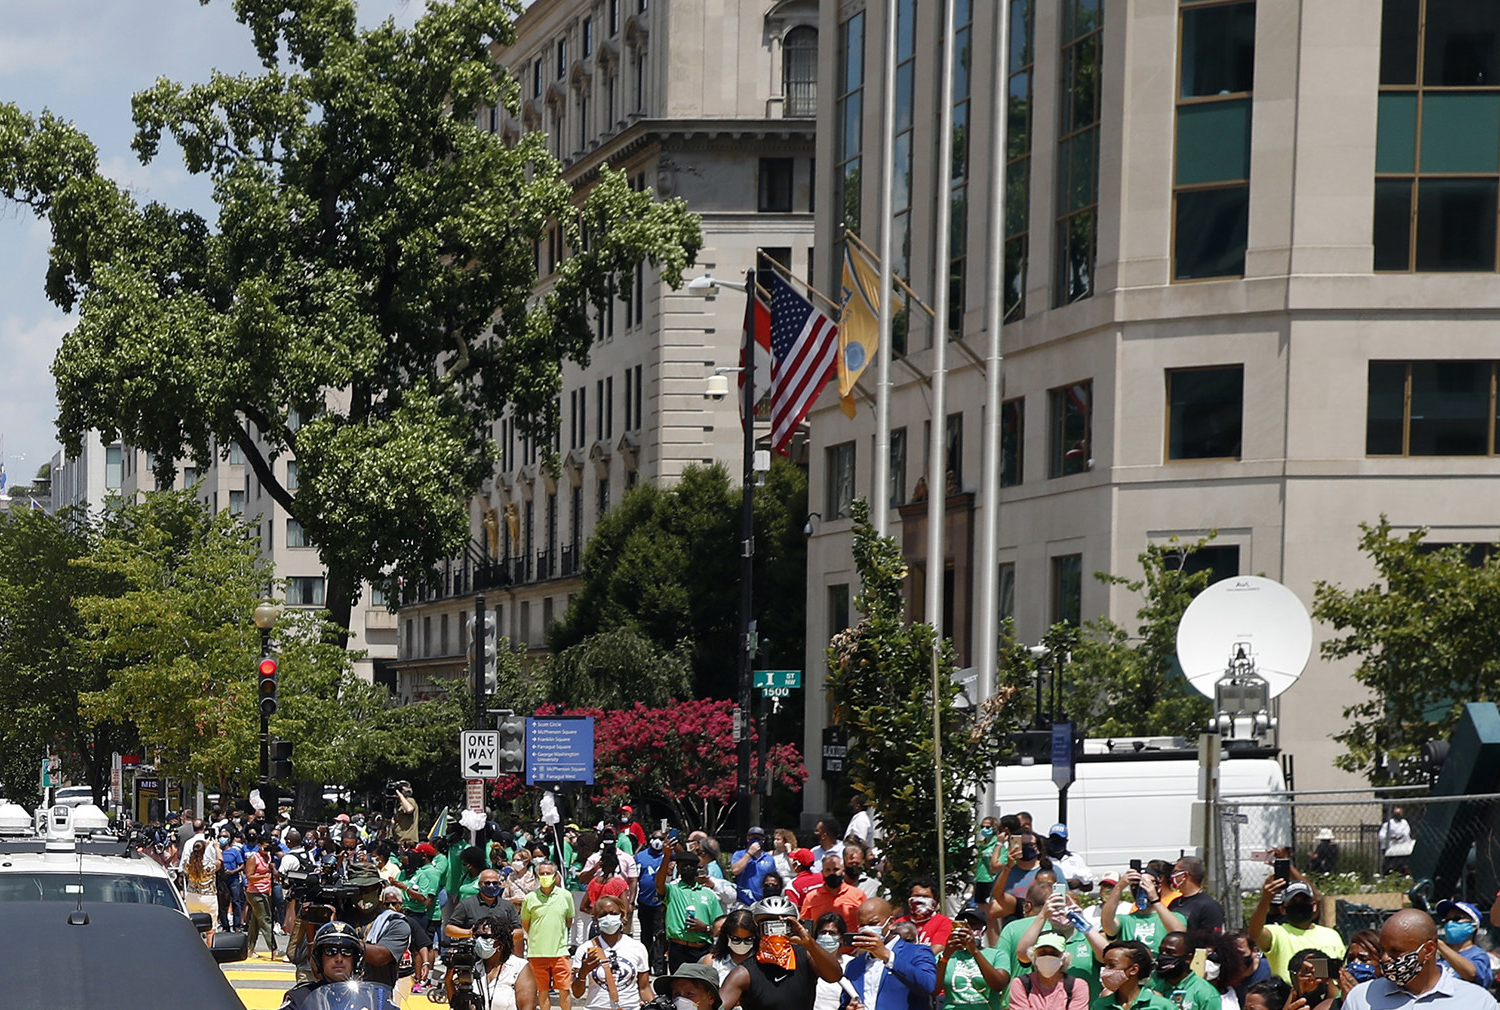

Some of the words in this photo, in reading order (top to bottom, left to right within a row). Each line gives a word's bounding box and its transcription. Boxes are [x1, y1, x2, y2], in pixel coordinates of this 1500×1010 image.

[766, 673, 775, 685] I
[764, 688, 789, 696] 1500
[469, 736, 494, 746] ONE
[468, 749, 495, 759] WAY
